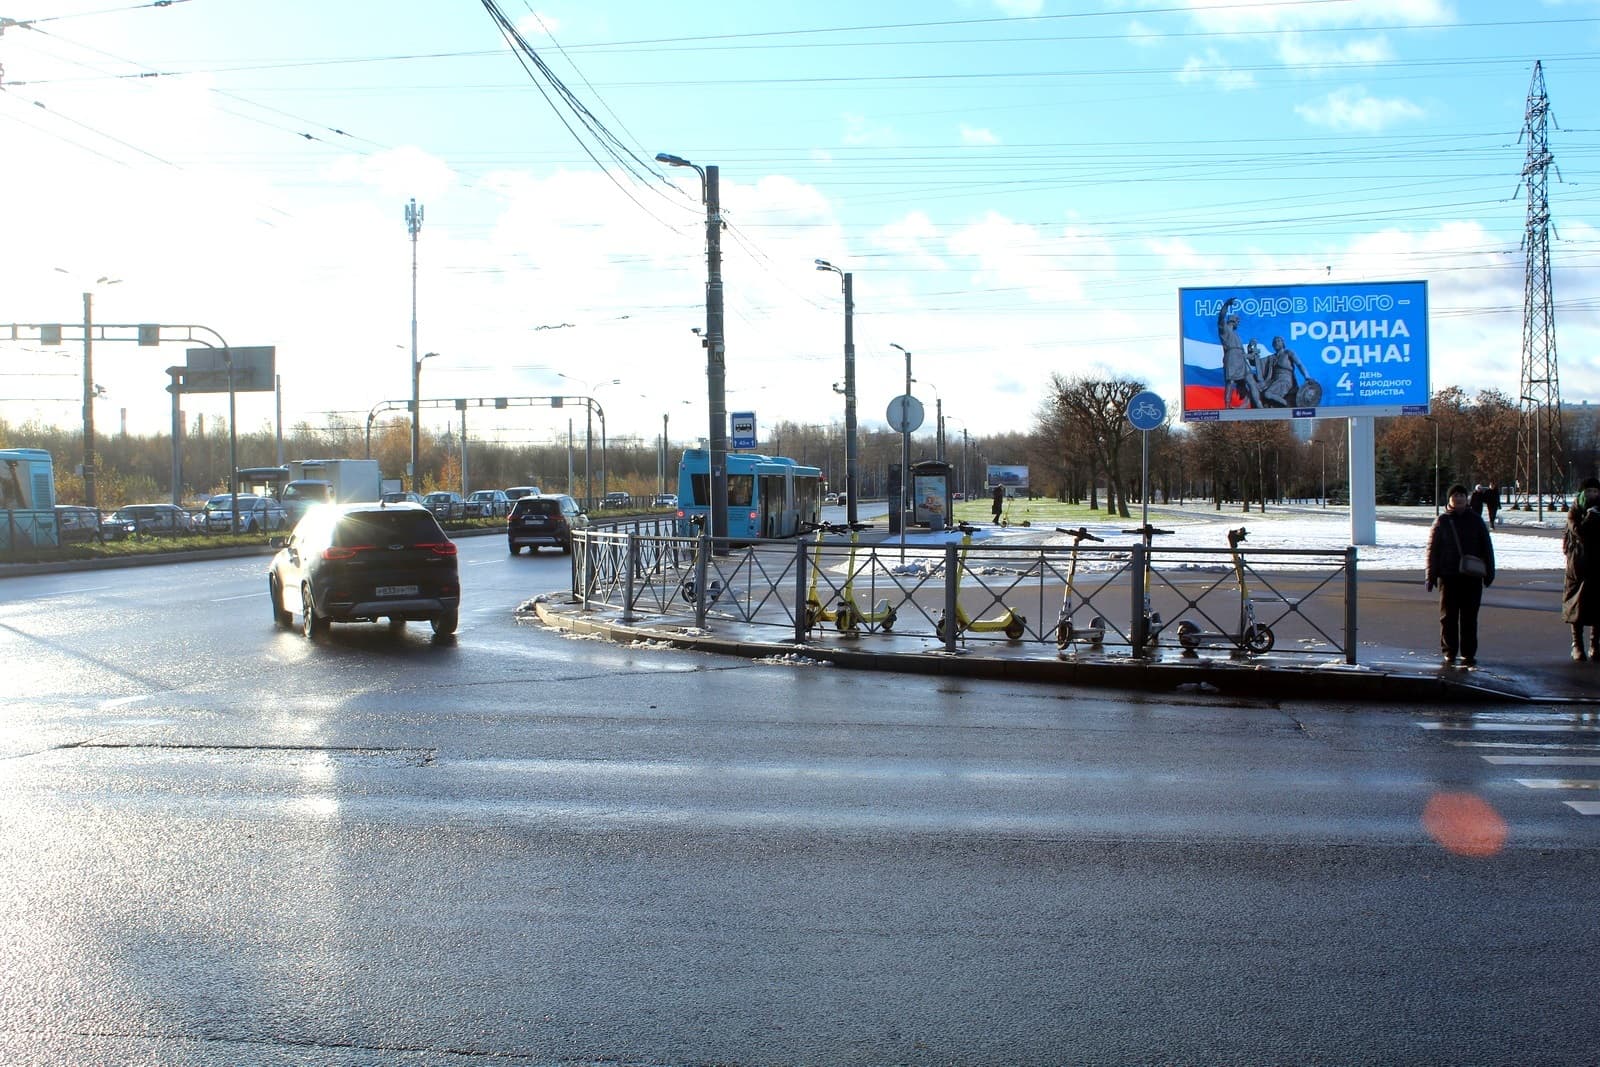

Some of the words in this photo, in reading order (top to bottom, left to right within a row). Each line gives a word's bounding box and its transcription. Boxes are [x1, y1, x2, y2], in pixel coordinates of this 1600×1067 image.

[1195, 296, 1308, 317] НАРОДОВ
[1314, 295, 1393, 313] МНОГО
[1290, 319, 1410, 342] РОДИНА
[1321, 343, 1411, 367] ОДНА!
[1336, 373, 1353, 391] 4
[1359, 371, 1383, 379] ДЕНЬ
[1359, 379, 1412, 388] НАРОДНОГО
[1359, 388, 1405, 397] ЕДИНСТВА
